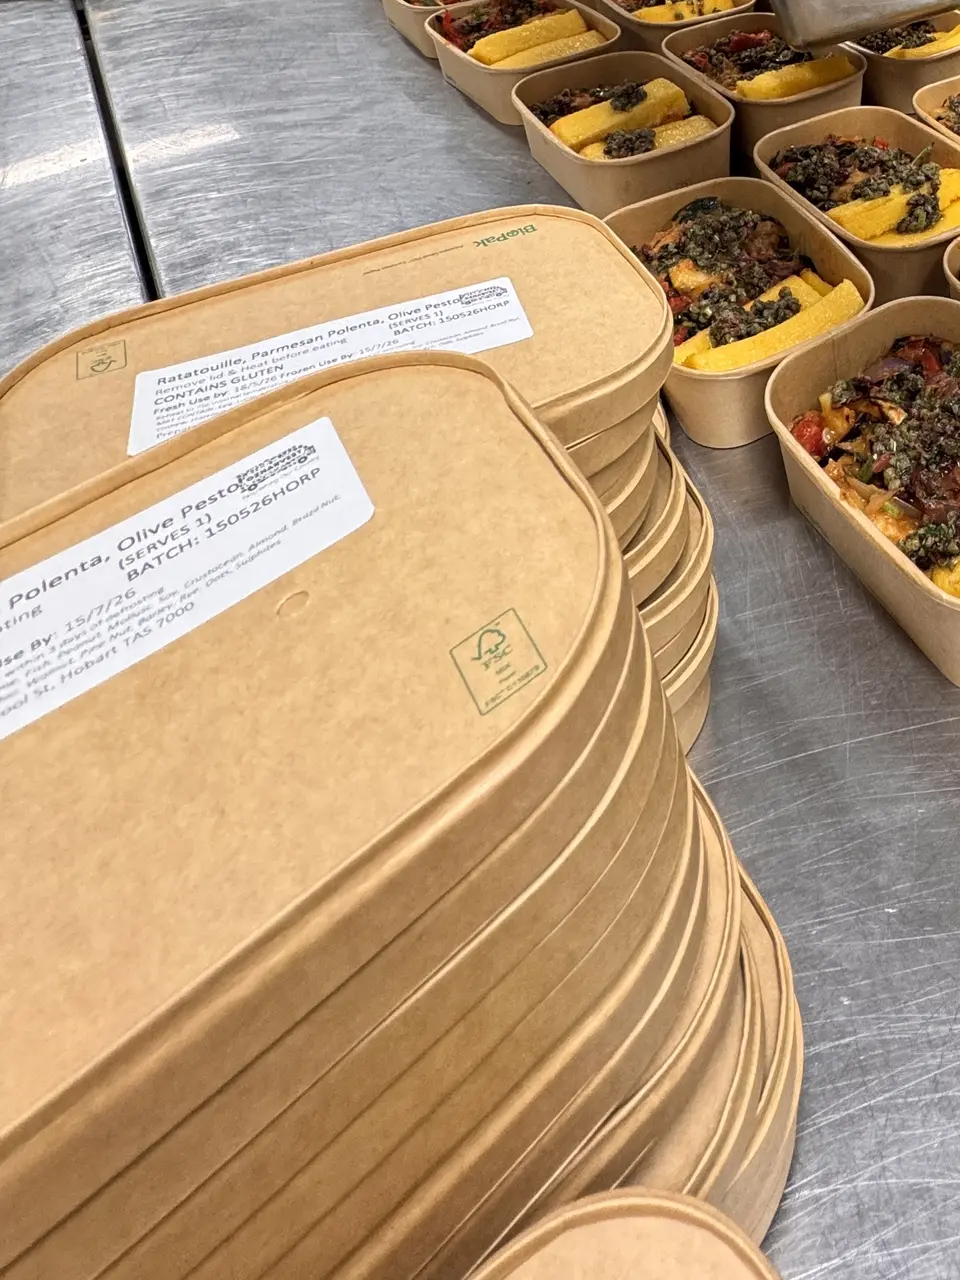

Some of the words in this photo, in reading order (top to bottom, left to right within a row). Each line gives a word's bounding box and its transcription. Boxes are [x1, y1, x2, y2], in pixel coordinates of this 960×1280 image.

[473, 223, 538, 248] BioPak
[157, 357, 247, 386] Ratatouille,
[251, 334, 324, 361] Parmesan
[327, 318, 385, 338] Polenta,
[388, 307, 421, 321] Olive
[425, 298, 461, 312] Pesto
[388, 314, 431, 330] (SERVES
[433, 309, 444, 319] 1)
[393, 320, 436, 336] BATCH:
[439, 300, 510, 324] 150526HORP
[153, 401, 186, 416] Fresh
[188, 395, 211, 406] Use
[233, 375, 278, 393] 18/5/26
[280, 364, 316, 379] Frozen
[318, 357, 338, 368] Use
[359, 338, 400, 355] 15/7/26
[153, 380, 228, 406] CONTAINS
[230, 363, 284, 385] GLUTEN
[155, 378, 206, 396] Remove
[209, 371, 224, 383] lid
[227, 369, 238, 377] &
[241, 360, 269, 373] Heat
[272, 349, 309, 364] before
[311, 337, 347, 353] eating
[8, 553, 110, 610] Polenta,
[117, 515, 174, 552] Olive
[180, 482, 240, 518] Pesto
[118, 524, 190, 571] (SERVES
[195, 512, 212, 529] 1)
[126, 536, 200, 582] BATCH:
[204, 467, 321, 539] 150526HORP
[65, 587, 137, 632] 15/7/26
[60, 644, 118, 685] Hobart
[122, 627, 153, 649] TAS
[156, 601, 195, 629] 7000
[481, 643, 514, 671] FSC
